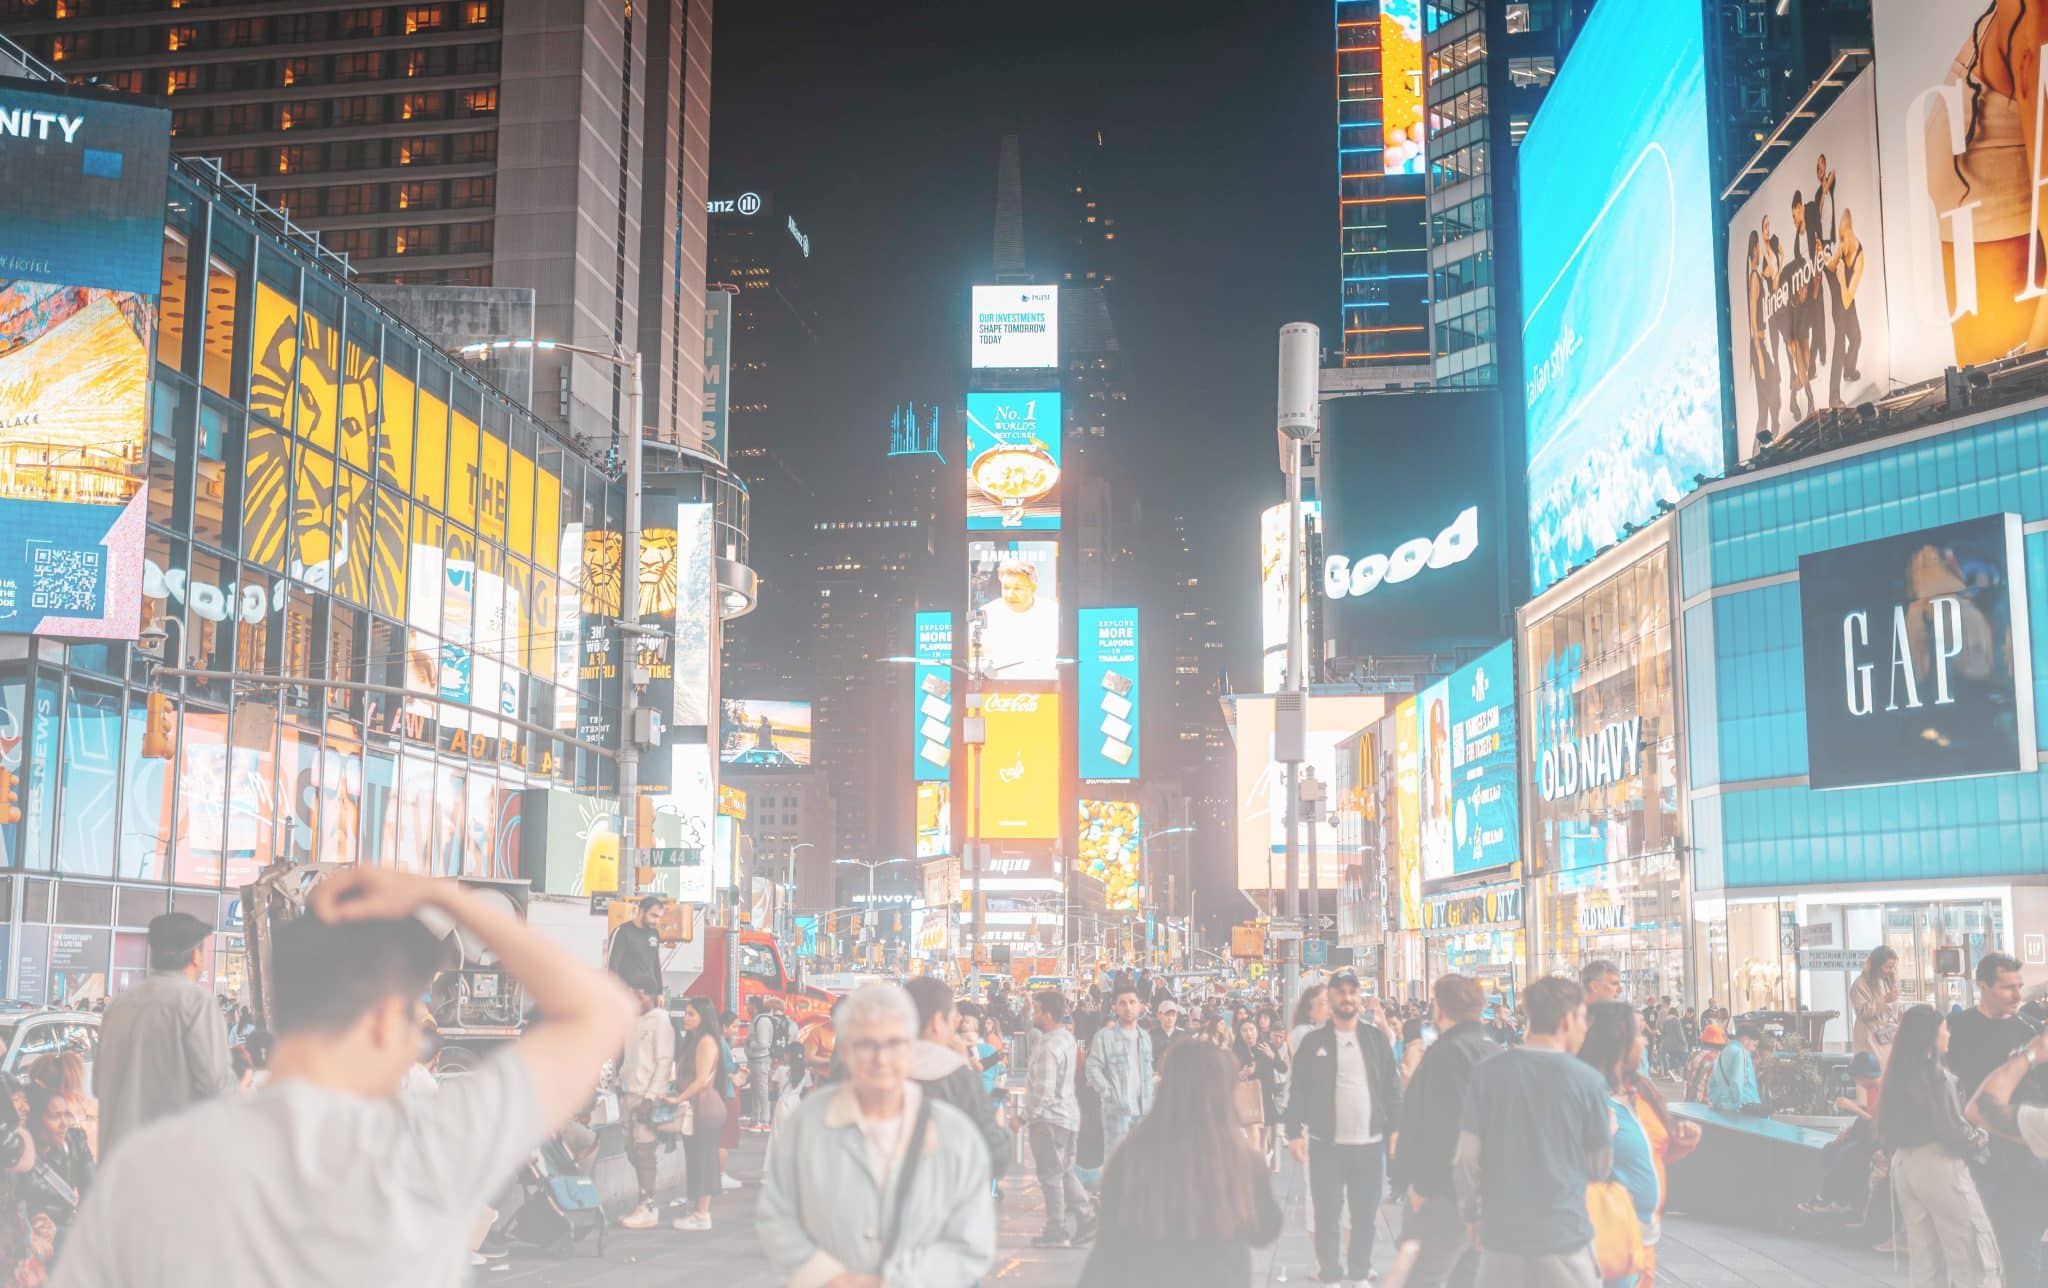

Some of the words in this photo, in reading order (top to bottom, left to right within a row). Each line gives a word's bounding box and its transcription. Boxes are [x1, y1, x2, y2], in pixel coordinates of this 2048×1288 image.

[979, 313, 995, 323] OUR
[996, 313, 1045, 323] INVESTMENTS
[979, 324, 1002, 334] SHAPE
[1004, 324, 1046, 334] TOMORROW
[980, 335, 1002, 345] TODAY
[701, 310, 720, 442] TIMES
[994, 405, 1021, 420] No.
[1024, 400, 1037, 420] 1
[466, 462, 505, 521] THE
[1098, 628, 1134, 638] MORE
[1842, 597, 1964, 716] GAP
[1541, 740, 1579, 802] OLD
[1580, 715, 1643, 790] NAVY
[653, 850, 664, 865] W
[669, 850, 686, 866] 44
